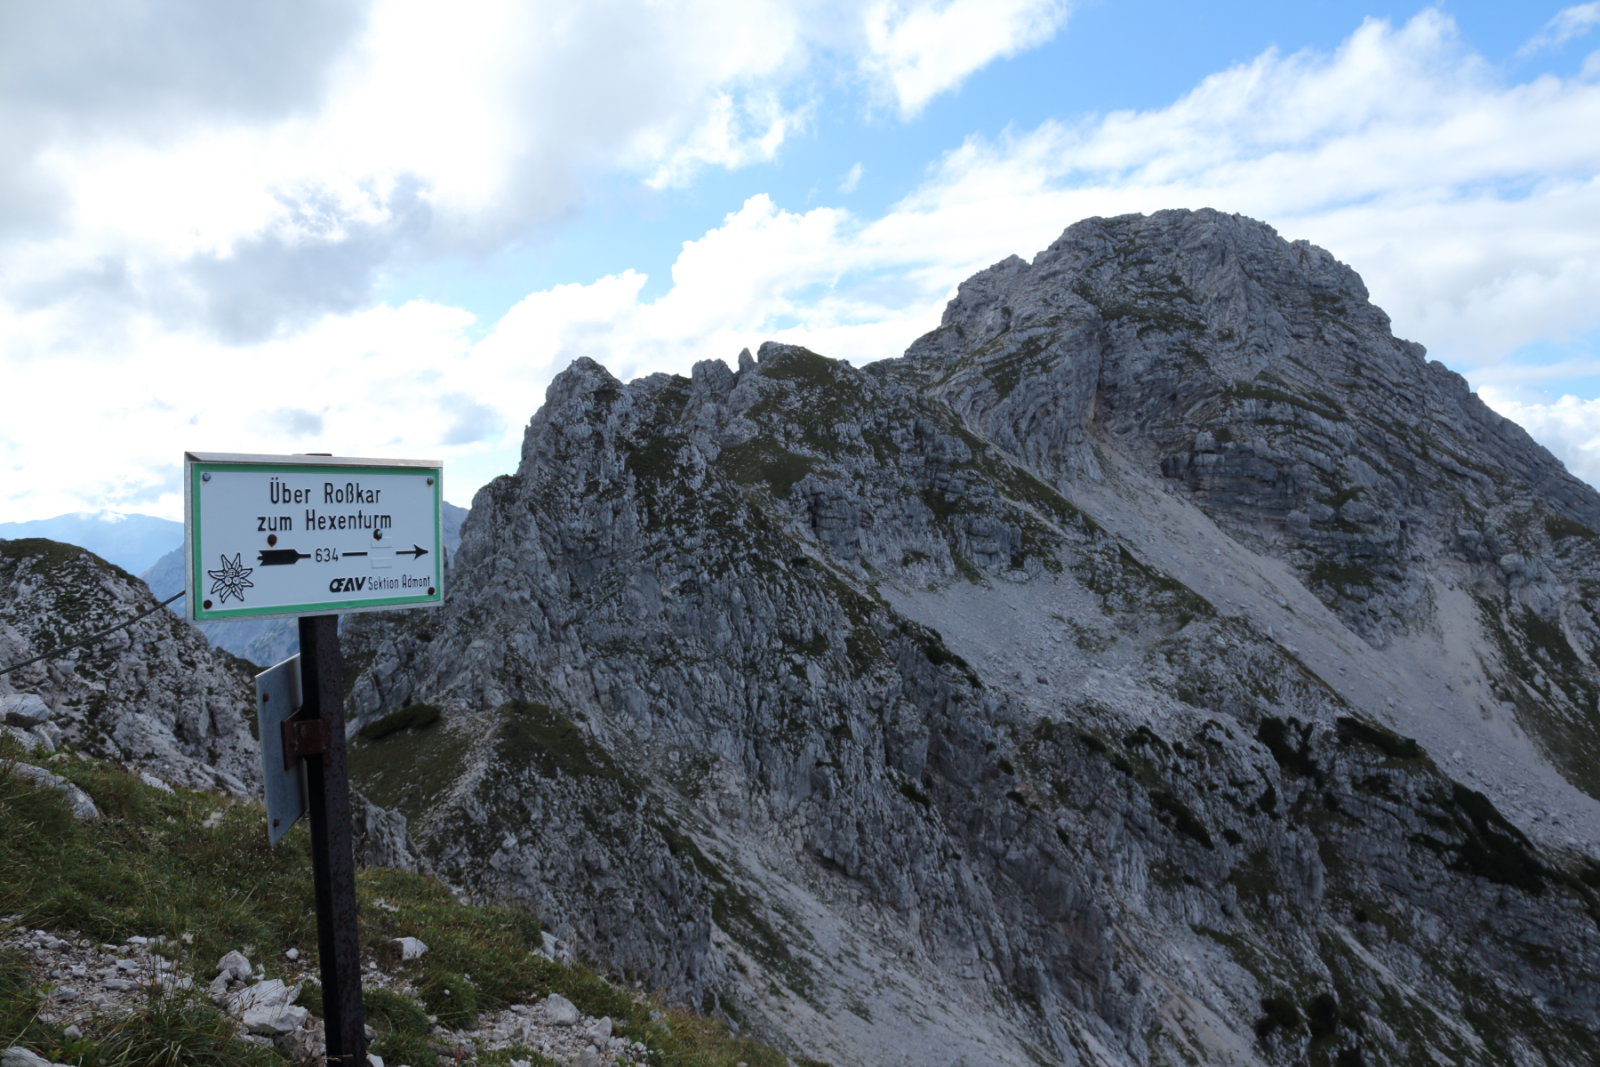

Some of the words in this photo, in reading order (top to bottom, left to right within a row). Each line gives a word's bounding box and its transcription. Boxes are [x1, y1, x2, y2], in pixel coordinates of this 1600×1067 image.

[269, 477, 311, 504] Über
[324, 482, 381, 504] Roßkar
[257, 515, 293, 532] zum
[306, 509, 392, 531] Hexenturm
[315, 548, 339, 563] 634
[368, 577, 399, 591] Sektion
[402, 575, 431, 589] Admont
